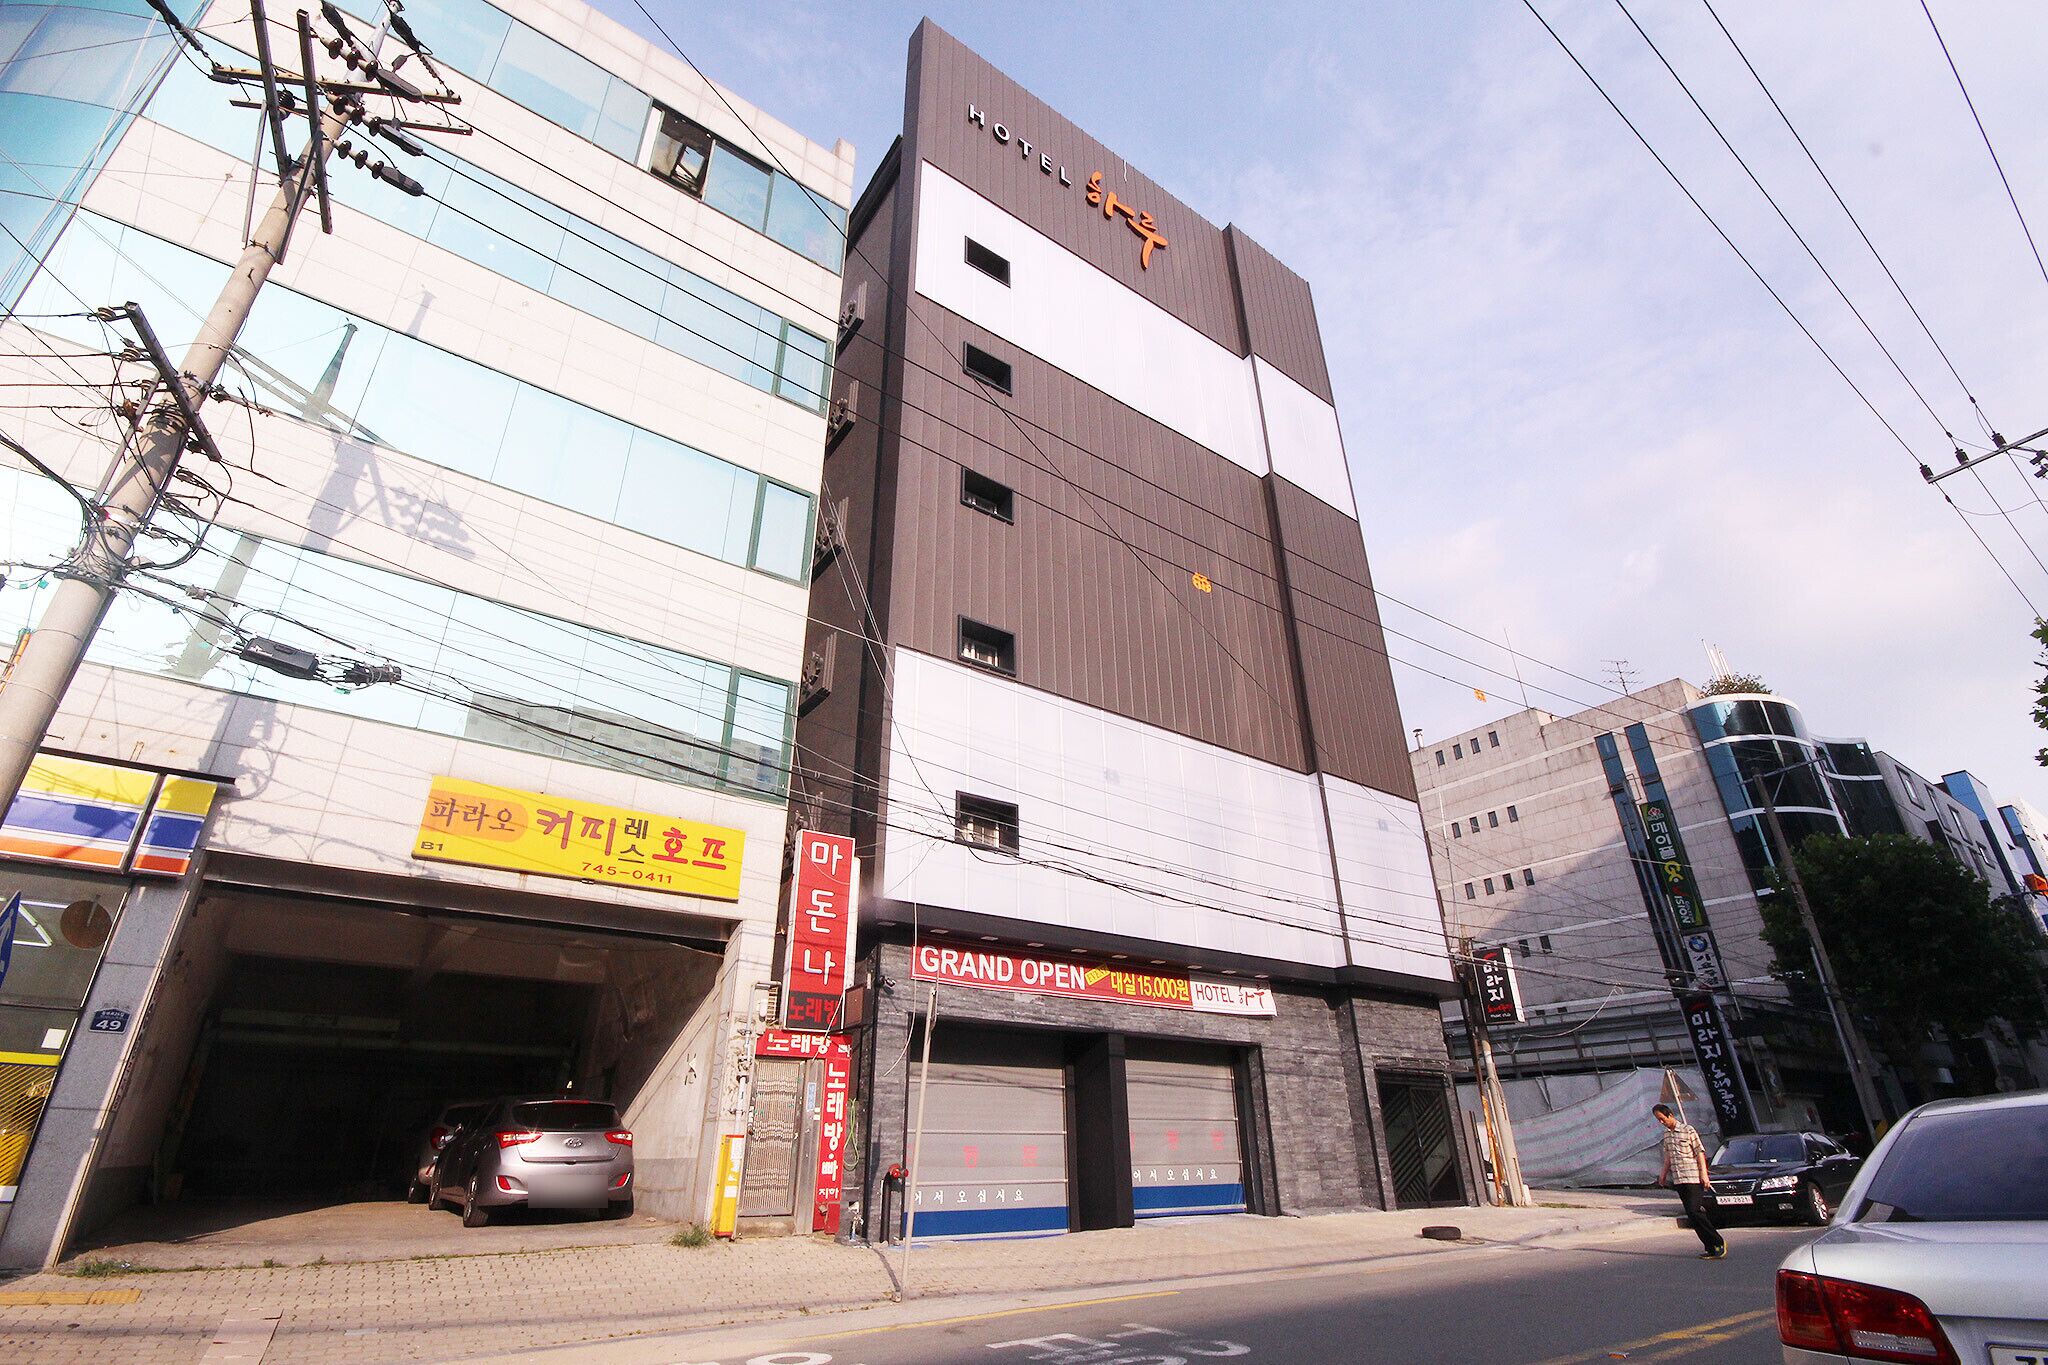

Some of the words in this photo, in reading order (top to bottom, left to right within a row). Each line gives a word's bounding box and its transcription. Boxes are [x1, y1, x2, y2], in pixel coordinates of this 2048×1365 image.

[968, 103, 1072, 188] HOTEL
[430, 798, 516, 833] 파라오
[651, 827, 727, 870] 호프
[421, 841, 444, 852] B1
[582, 861, 673, 885] 745-0411
[803, 840, 844, 987] 마돈나
[920, 946, 1014, 986] GRAND
[1020, 961, 1086, 990] OPEN
[1110, 971, 1136, 996] 대실
[1137, 974, 1190, 1002] 15,000원
[1195, 981, 1235, 1004] HOTEL
[95, 1019, 122, 1030] 49
[766, 1033, 832, 1054] 노래방
[818, 1187, 840, 1200] 지하
